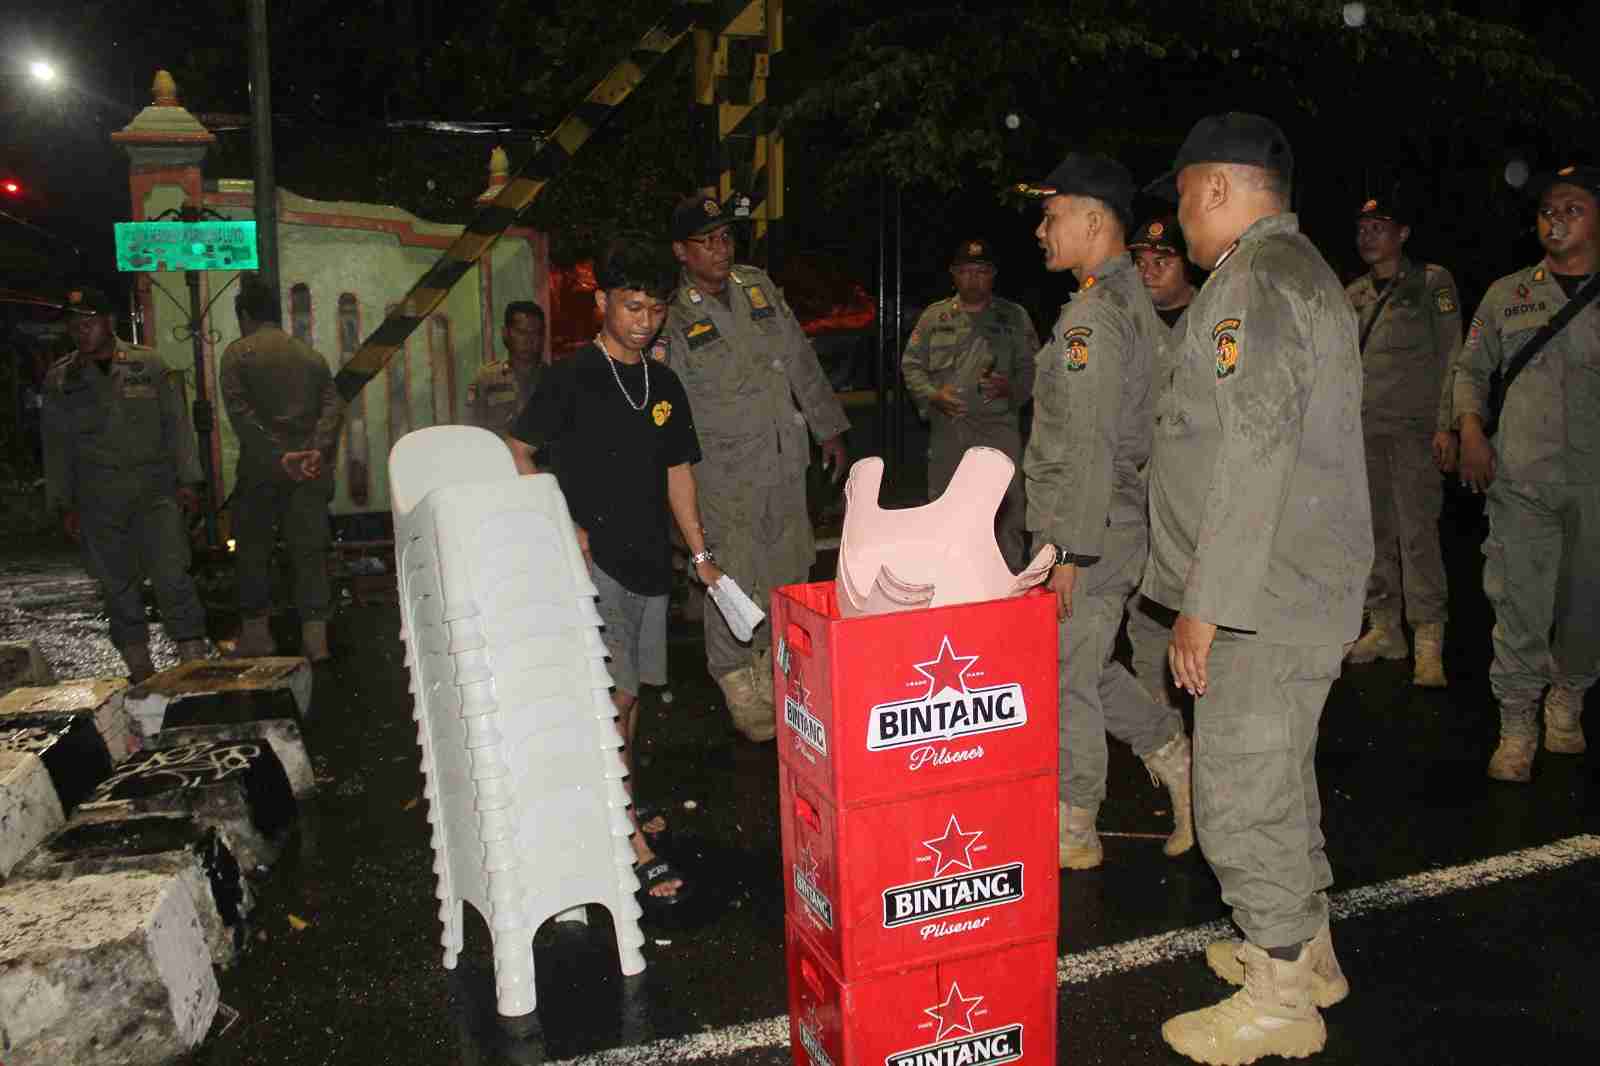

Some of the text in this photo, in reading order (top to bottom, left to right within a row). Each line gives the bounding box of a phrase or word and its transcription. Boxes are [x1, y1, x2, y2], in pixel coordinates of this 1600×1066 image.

[879, 692, 1017, 741] BINTANG
[908, 744, 985, 770] Pilsener
[919, 915, 990, 941] Pilsener
